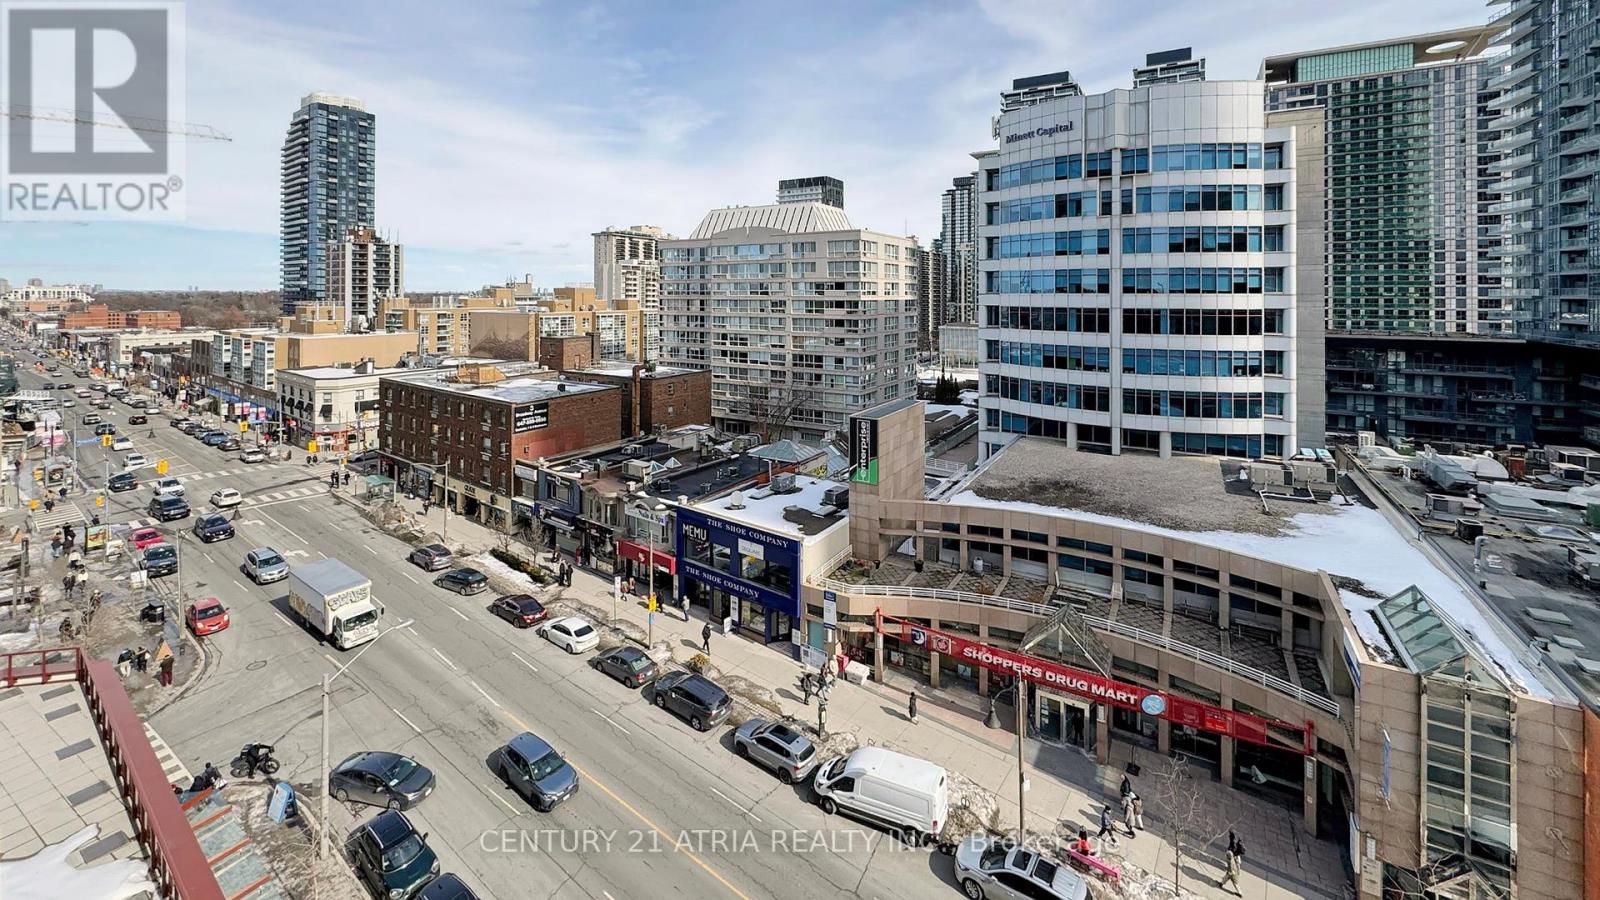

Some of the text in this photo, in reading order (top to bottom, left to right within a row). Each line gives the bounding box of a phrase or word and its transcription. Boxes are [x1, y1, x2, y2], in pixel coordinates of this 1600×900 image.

[1006, 121, 1074, 144] Minett Capital
[860, 421, 868, 481] enterprise
[682, 522, 707, 541] MEMU
[706, 518, 790, 549] THE SHOE COMPANY
[685, 565, 700, 576] THE
[702, 571, 722, 584] SHOE
[723, 579, 760, 599] COMPANY
[962, 645, 1138, 706] SHOPPERS DRUG MART
